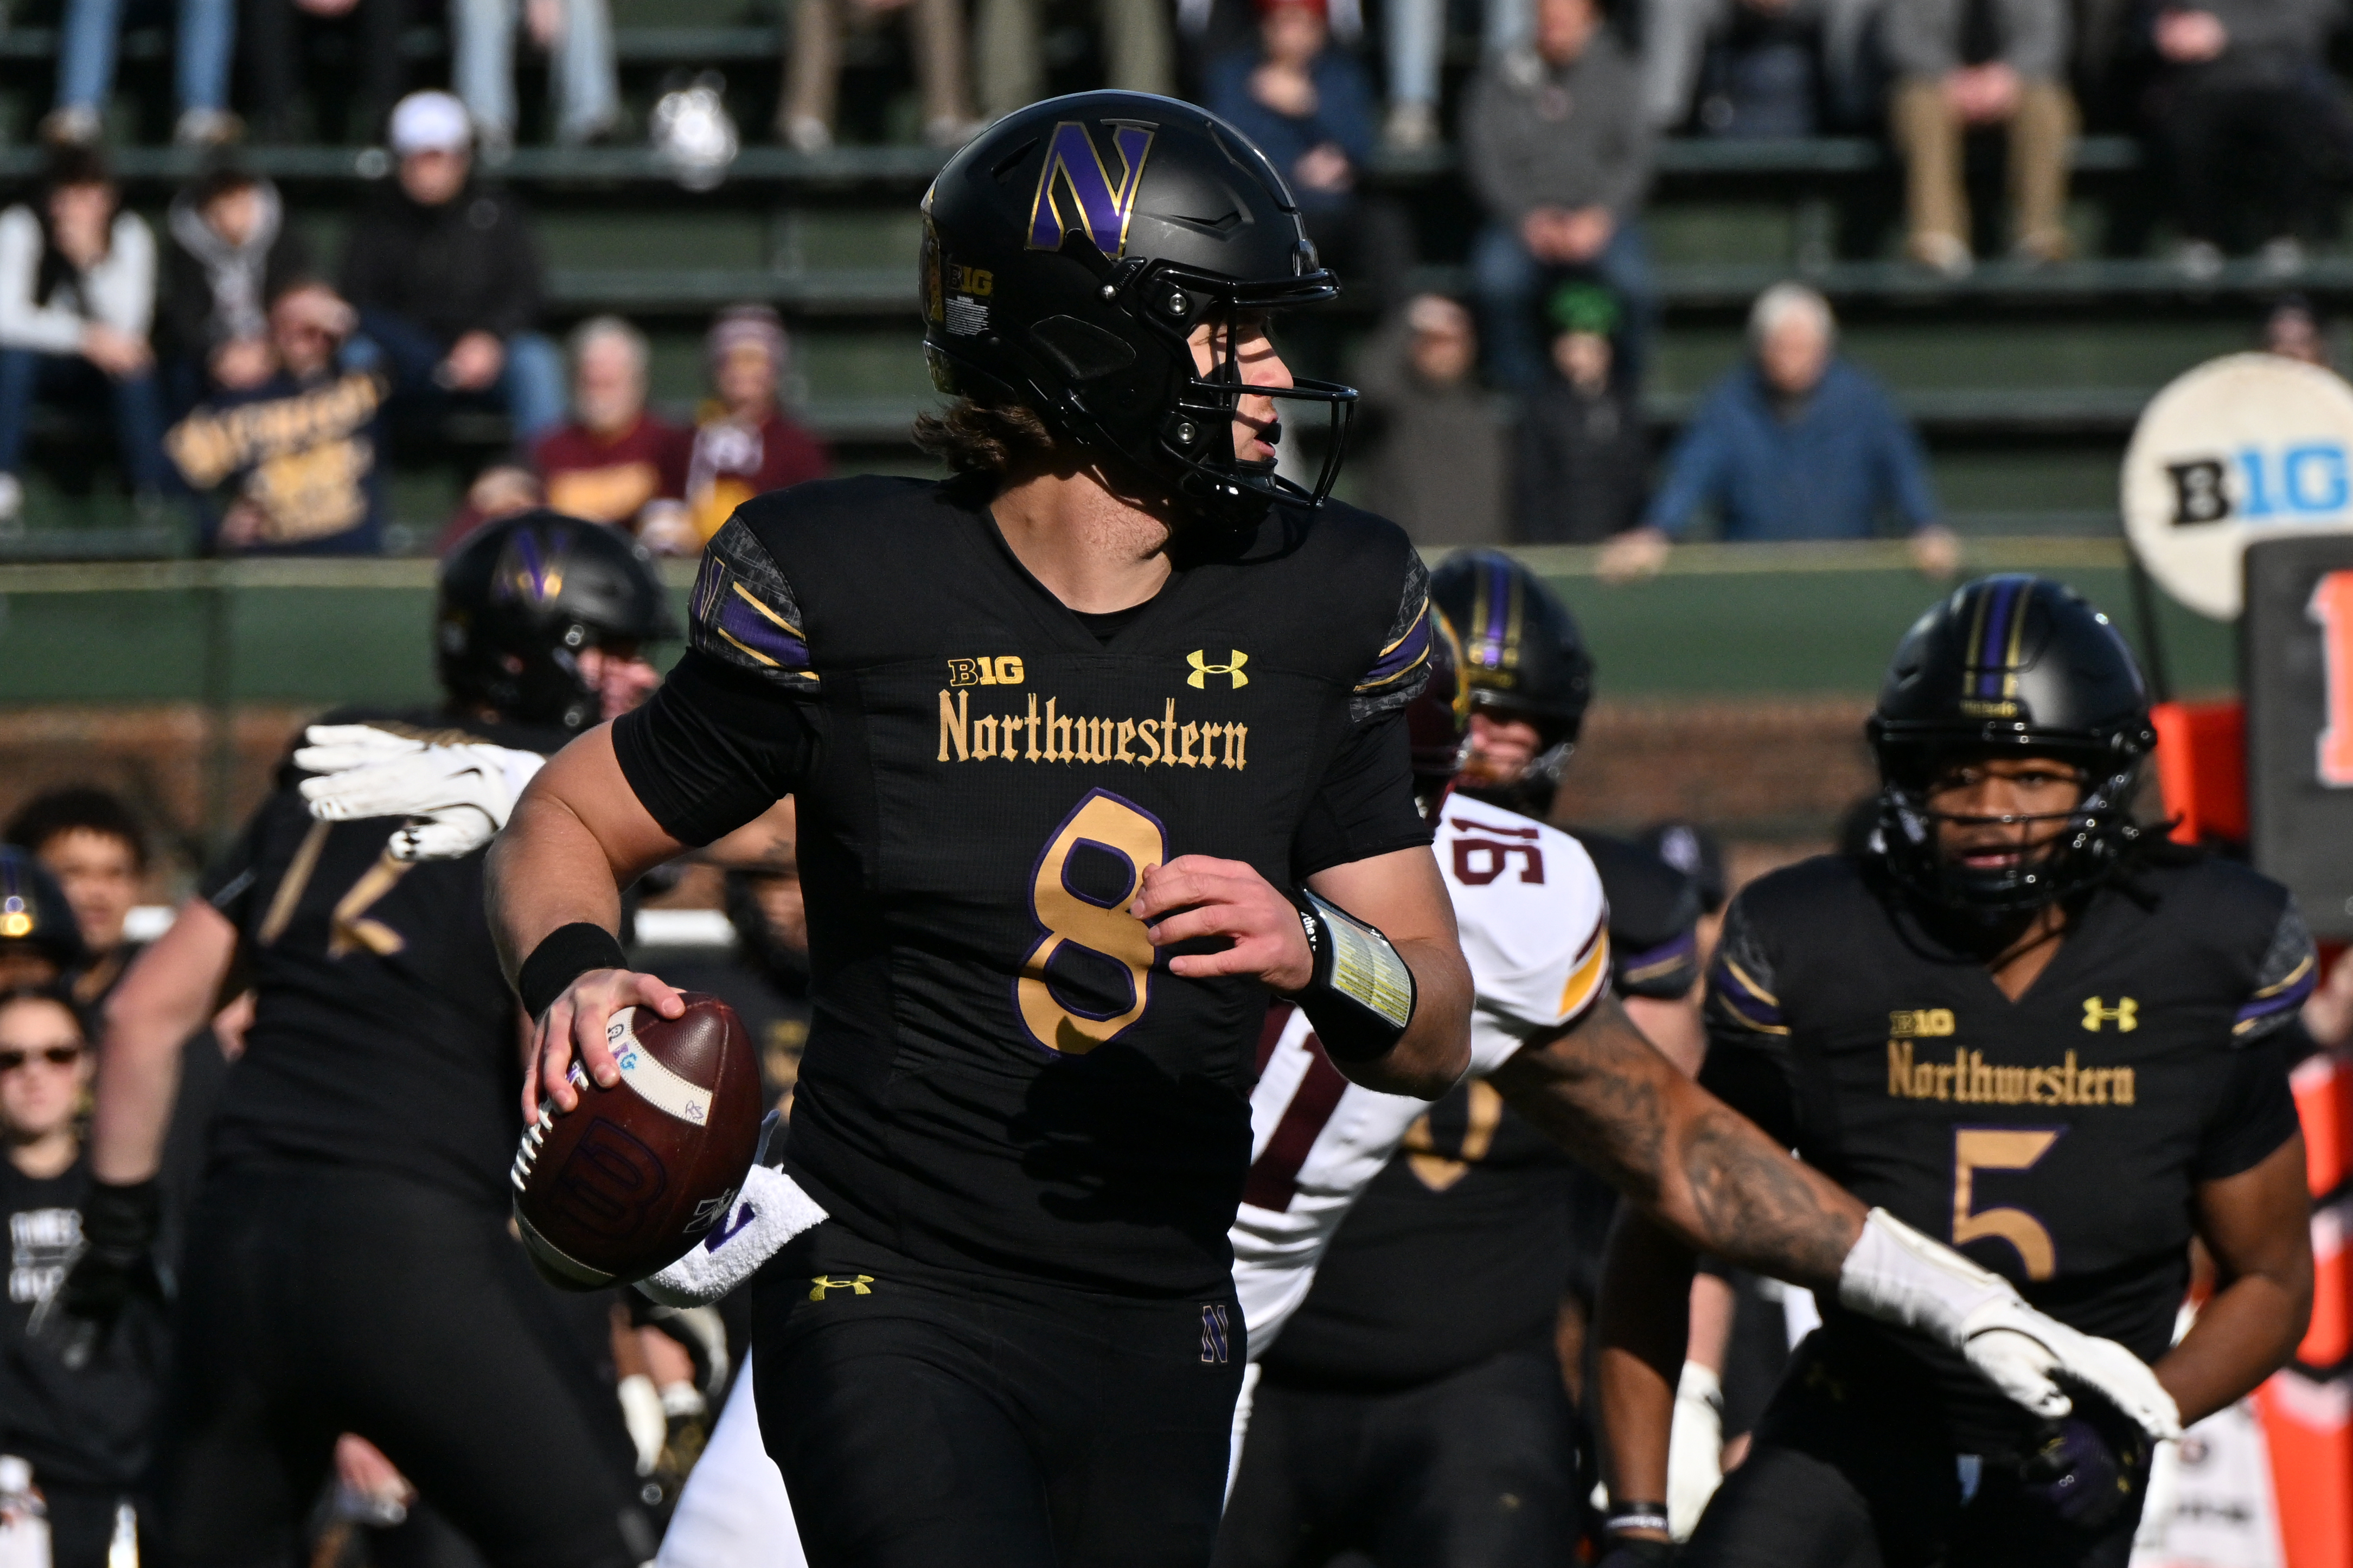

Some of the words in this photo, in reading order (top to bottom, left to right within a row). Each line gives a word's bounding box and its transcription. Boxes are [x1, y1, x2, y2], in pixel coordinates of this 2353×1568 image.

[1025, 121, 1154, 260] N
[937, 688, 1248, 771] Northwestern
[1011, 786, 1169, 1059] 8
[1888, 1038, 2136, 1106] Northwestern
[1952, 1124, 2069, 1282] 5
[1201, 1305, 1228, 1363] N
